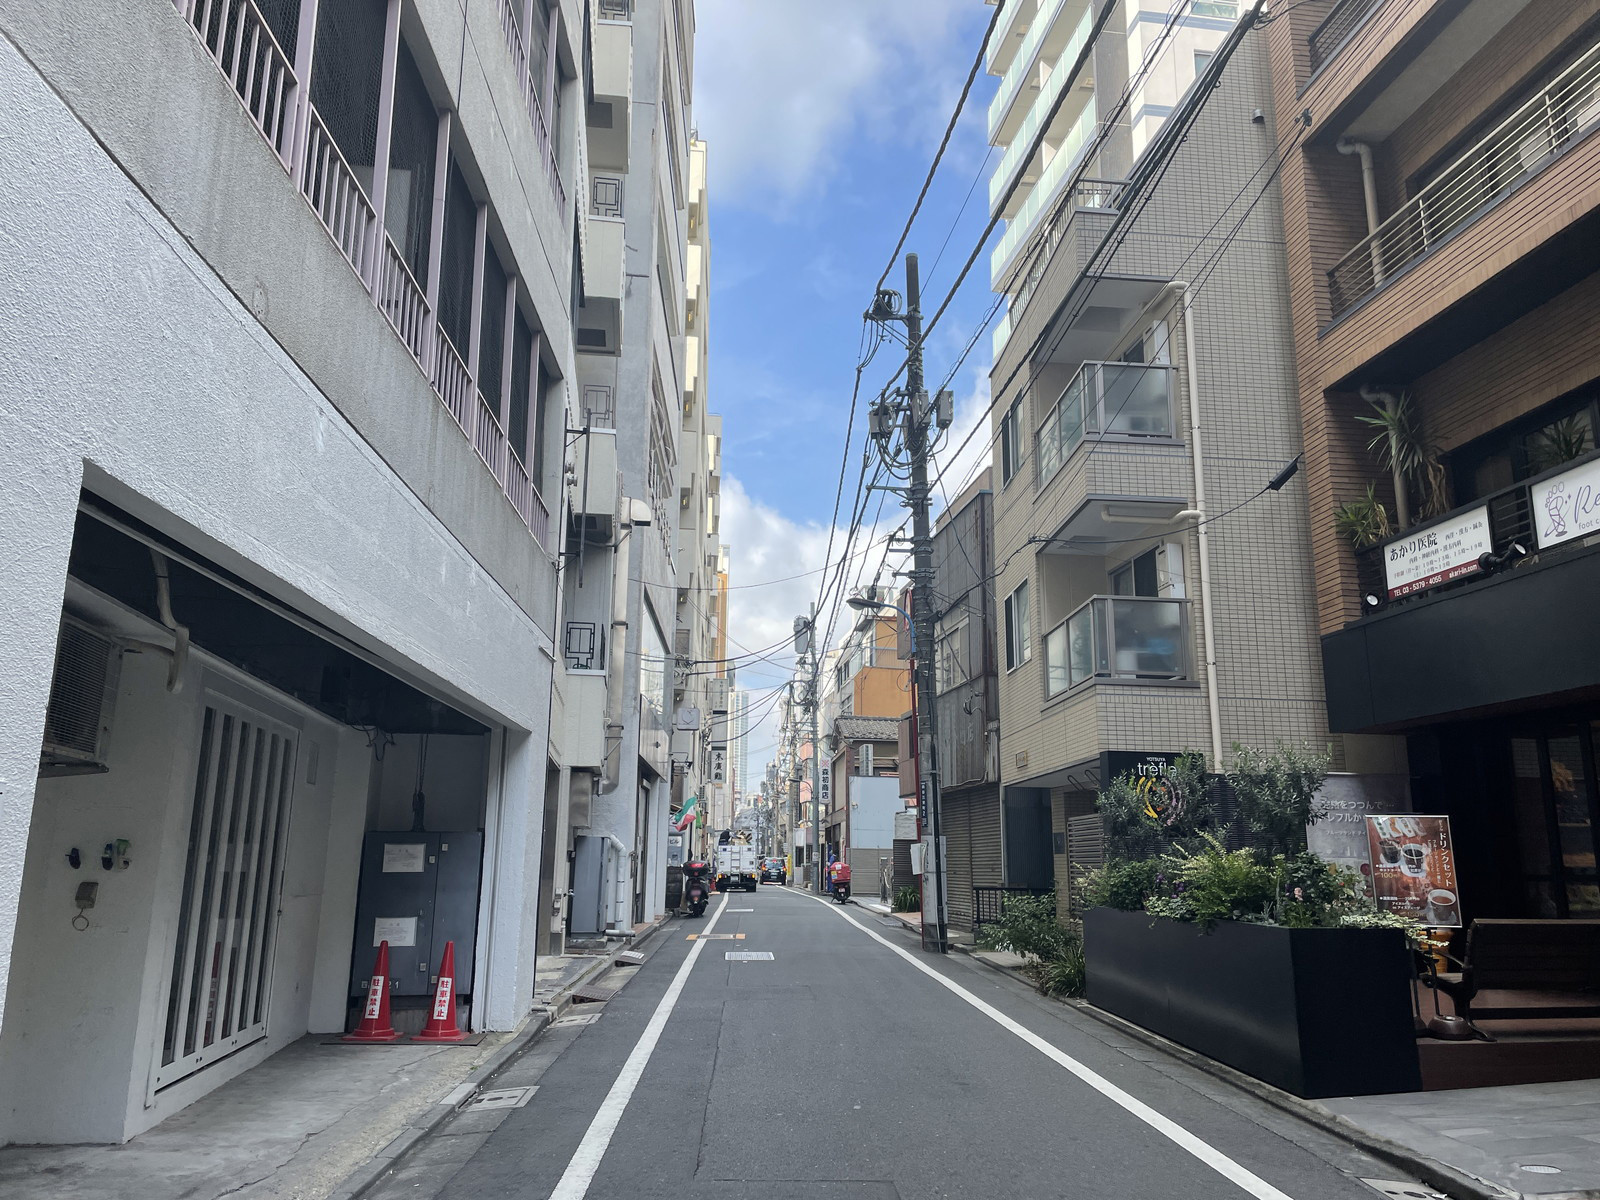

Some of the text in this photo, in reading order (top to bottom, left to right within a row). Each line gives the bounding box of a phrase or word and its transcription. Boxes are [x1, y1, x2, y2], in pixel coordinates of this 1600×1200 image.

[1579, 520, 1593, 530] foot
[1390, 531, 1438, 562] あかり医院
[1394, 589, 1402, 597] TEL
[1440, 833, 1453, 887] ドリンクセット
[368, 978, 380, 1017] 駐車禁止
[436, 980, 449, 1018] 駐車禁止
